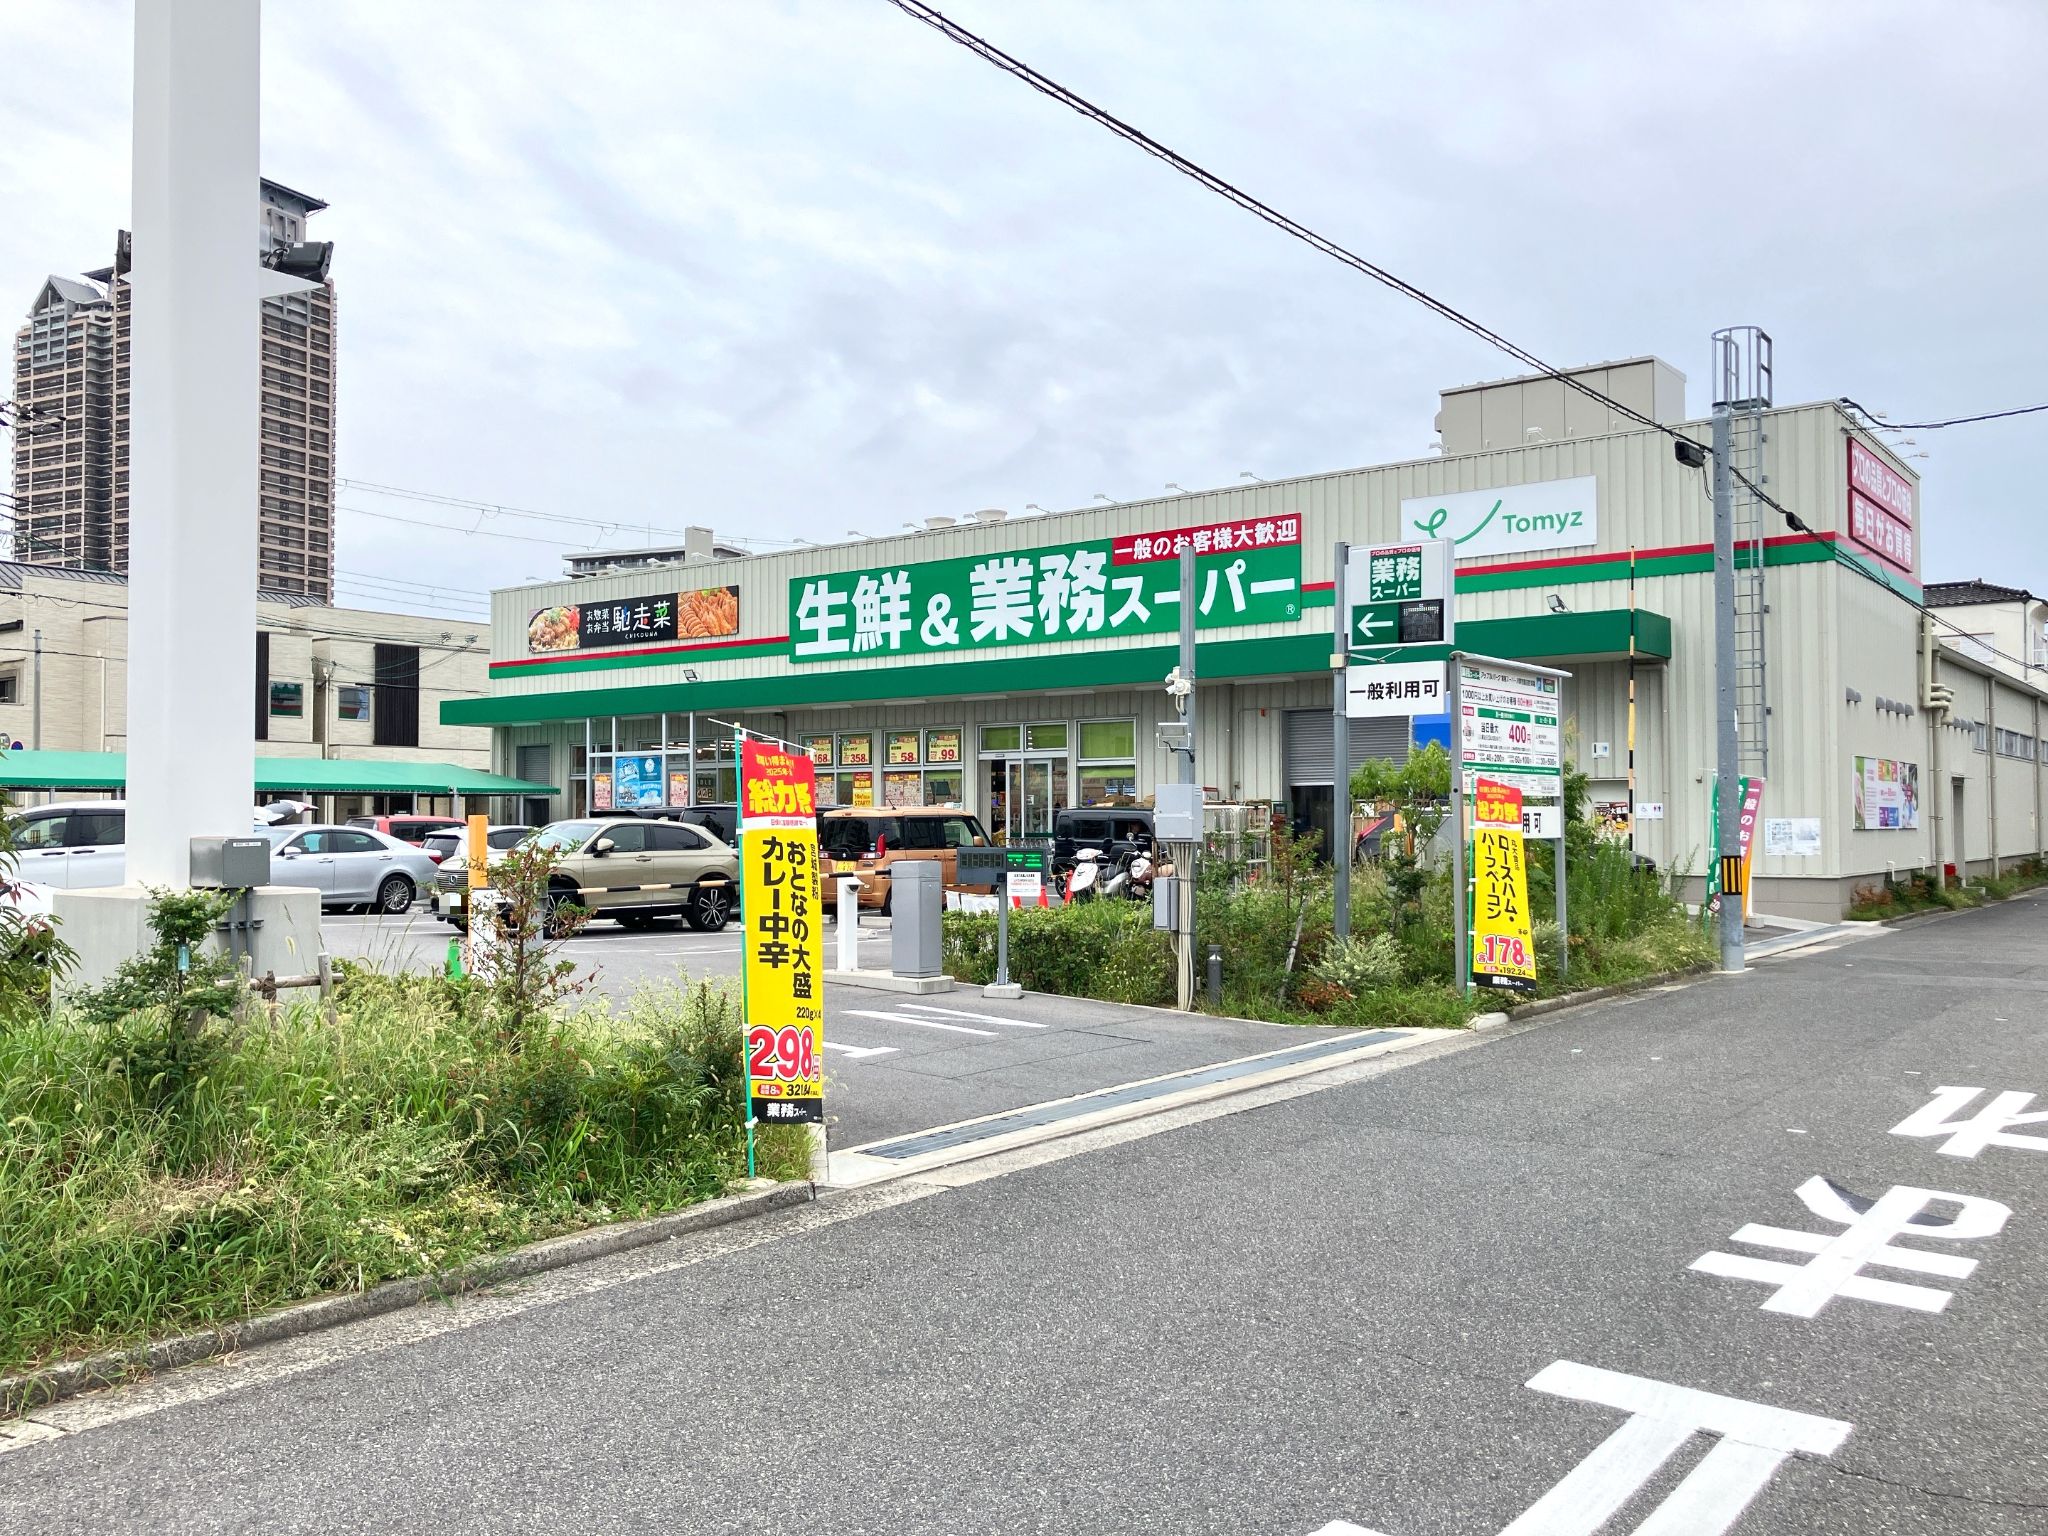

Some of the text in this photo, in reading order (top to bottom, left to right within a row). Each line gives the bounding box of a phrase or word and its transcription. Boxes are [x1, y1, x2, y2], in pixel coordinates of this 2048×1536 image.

[1502, 511, 1583, 534] Tomyz
[1114, 519, 1297, 561] 一般のお客様大歓迎
[1371, 556, 1420, 585] 業務
[1371, 583, 1421, 600] スーパー
[586, 607, 610, 621] お惣菜
[612, 600, 671, 632] 馳走菜
[586, 621, 610, 634] お弁当
[1349, 679, 1440, 701] 一般利用可
[901, 751, 914, 762] 58
[941, 749, 955, 760] 99
[1481, 832, 1501, 919] ハーフベーコン
[758, 836, 790, 969] カレー中辛
[786, 841, 812, 999] おとなの大盛
